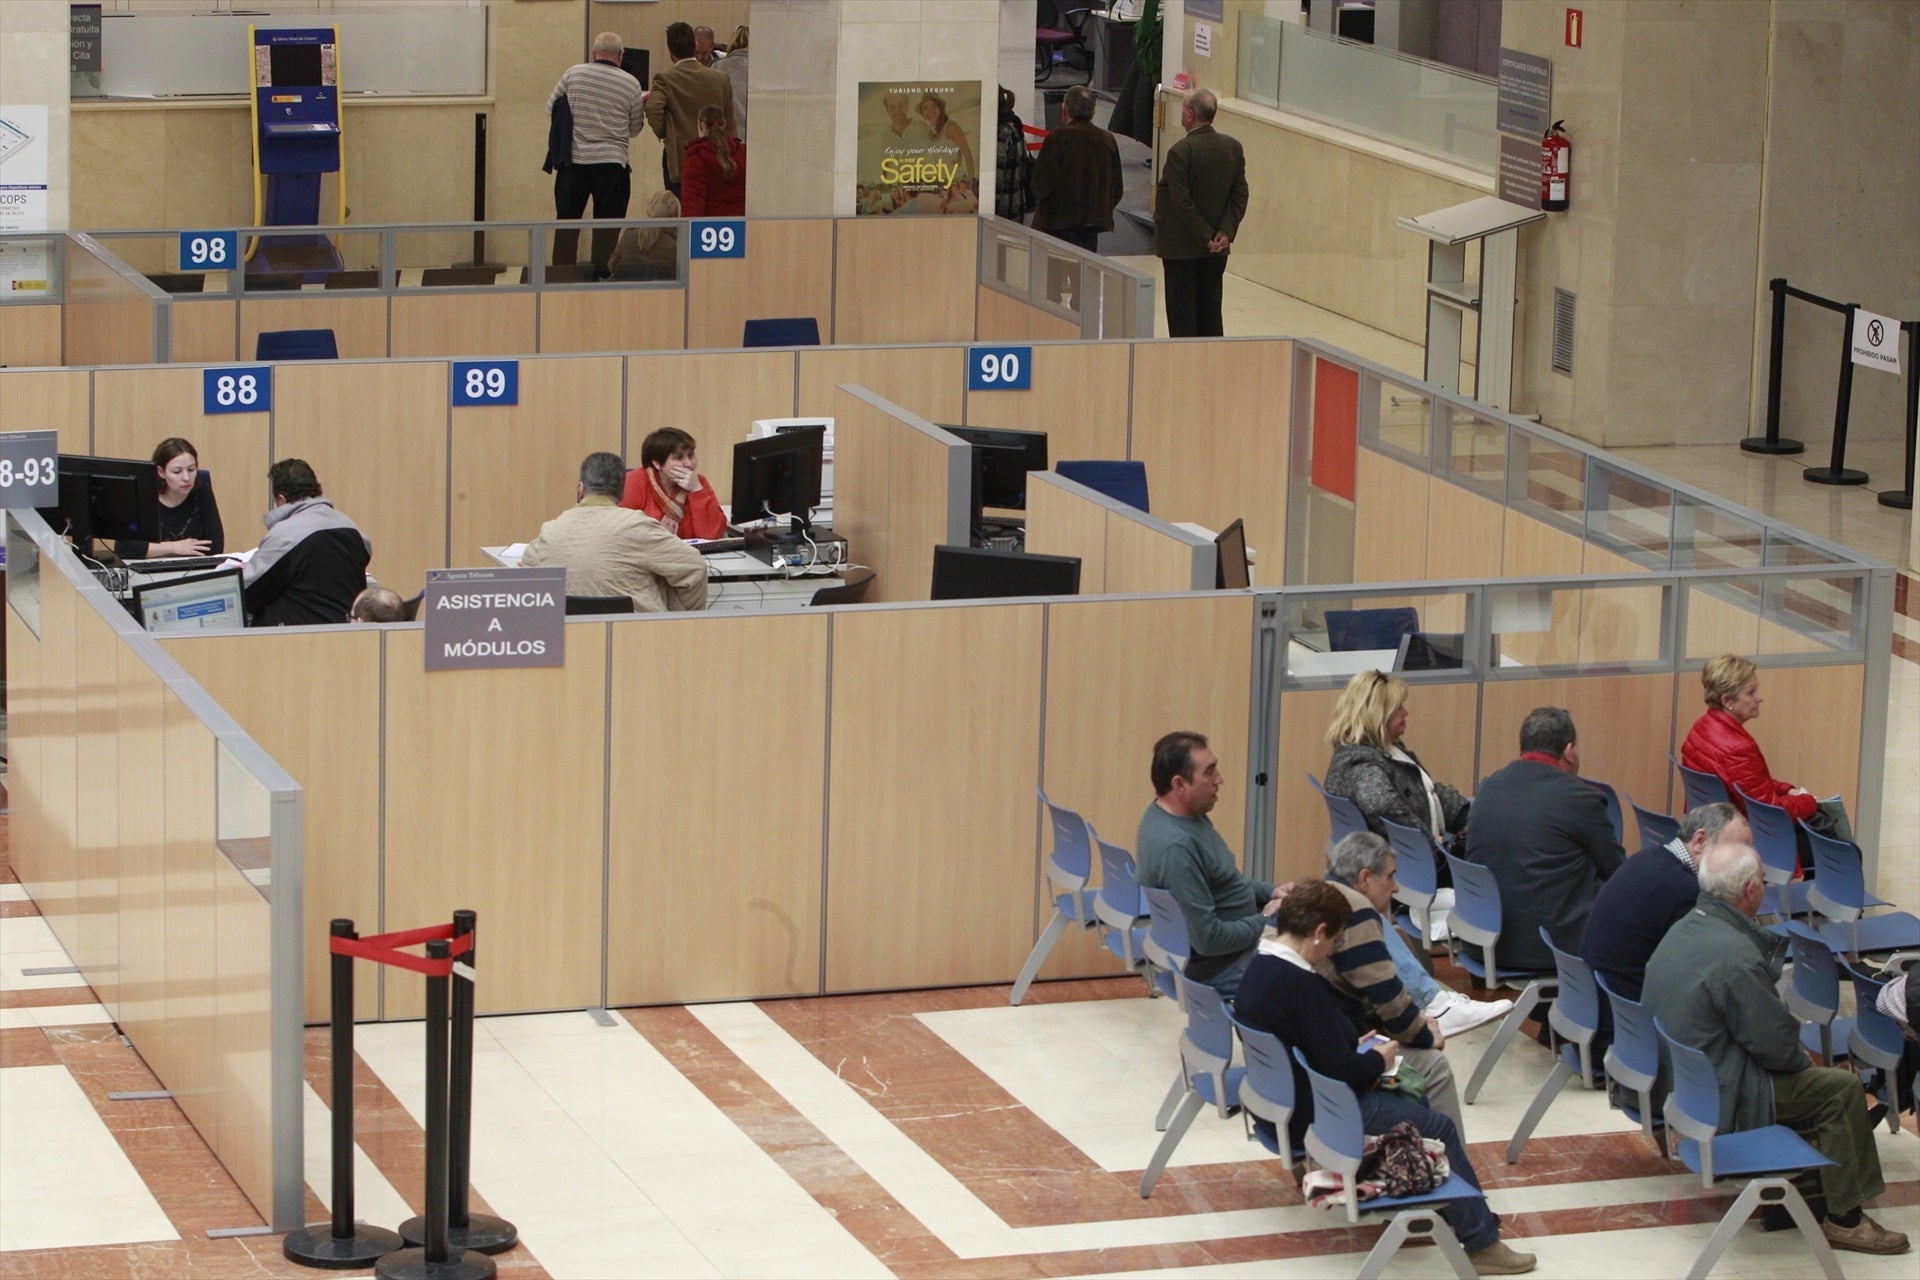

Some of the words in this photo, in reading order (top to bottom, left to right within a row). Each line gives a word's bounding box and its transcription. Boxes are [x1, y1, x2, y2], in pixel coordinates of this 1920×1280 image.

[884, 147, 905, 157] Enjoy
[906, 148, 925, 157] your
[927, 145, 959, 157] Holidays
[880, 157, 959, 190] Safety
[0, 194, 27, 205] COPS
[191, 237, 226, 264] 98
[701, 226, 735, 252] 99
[981, 353, 1019, 383] 90
[1854, 346, 1879, 360] PROHIBIDO
[1880, 354, 1897, 364] PASAR
[217, 374, 258, 406] 88
[465, 368, 506, 398] 89
[0, 456, 56, 488] 8-93
[436, 592, 555, 610] ASISTENCIA
[487, 617, 502, 632] A
[444, 639, 546, 658] MÓDULOS
